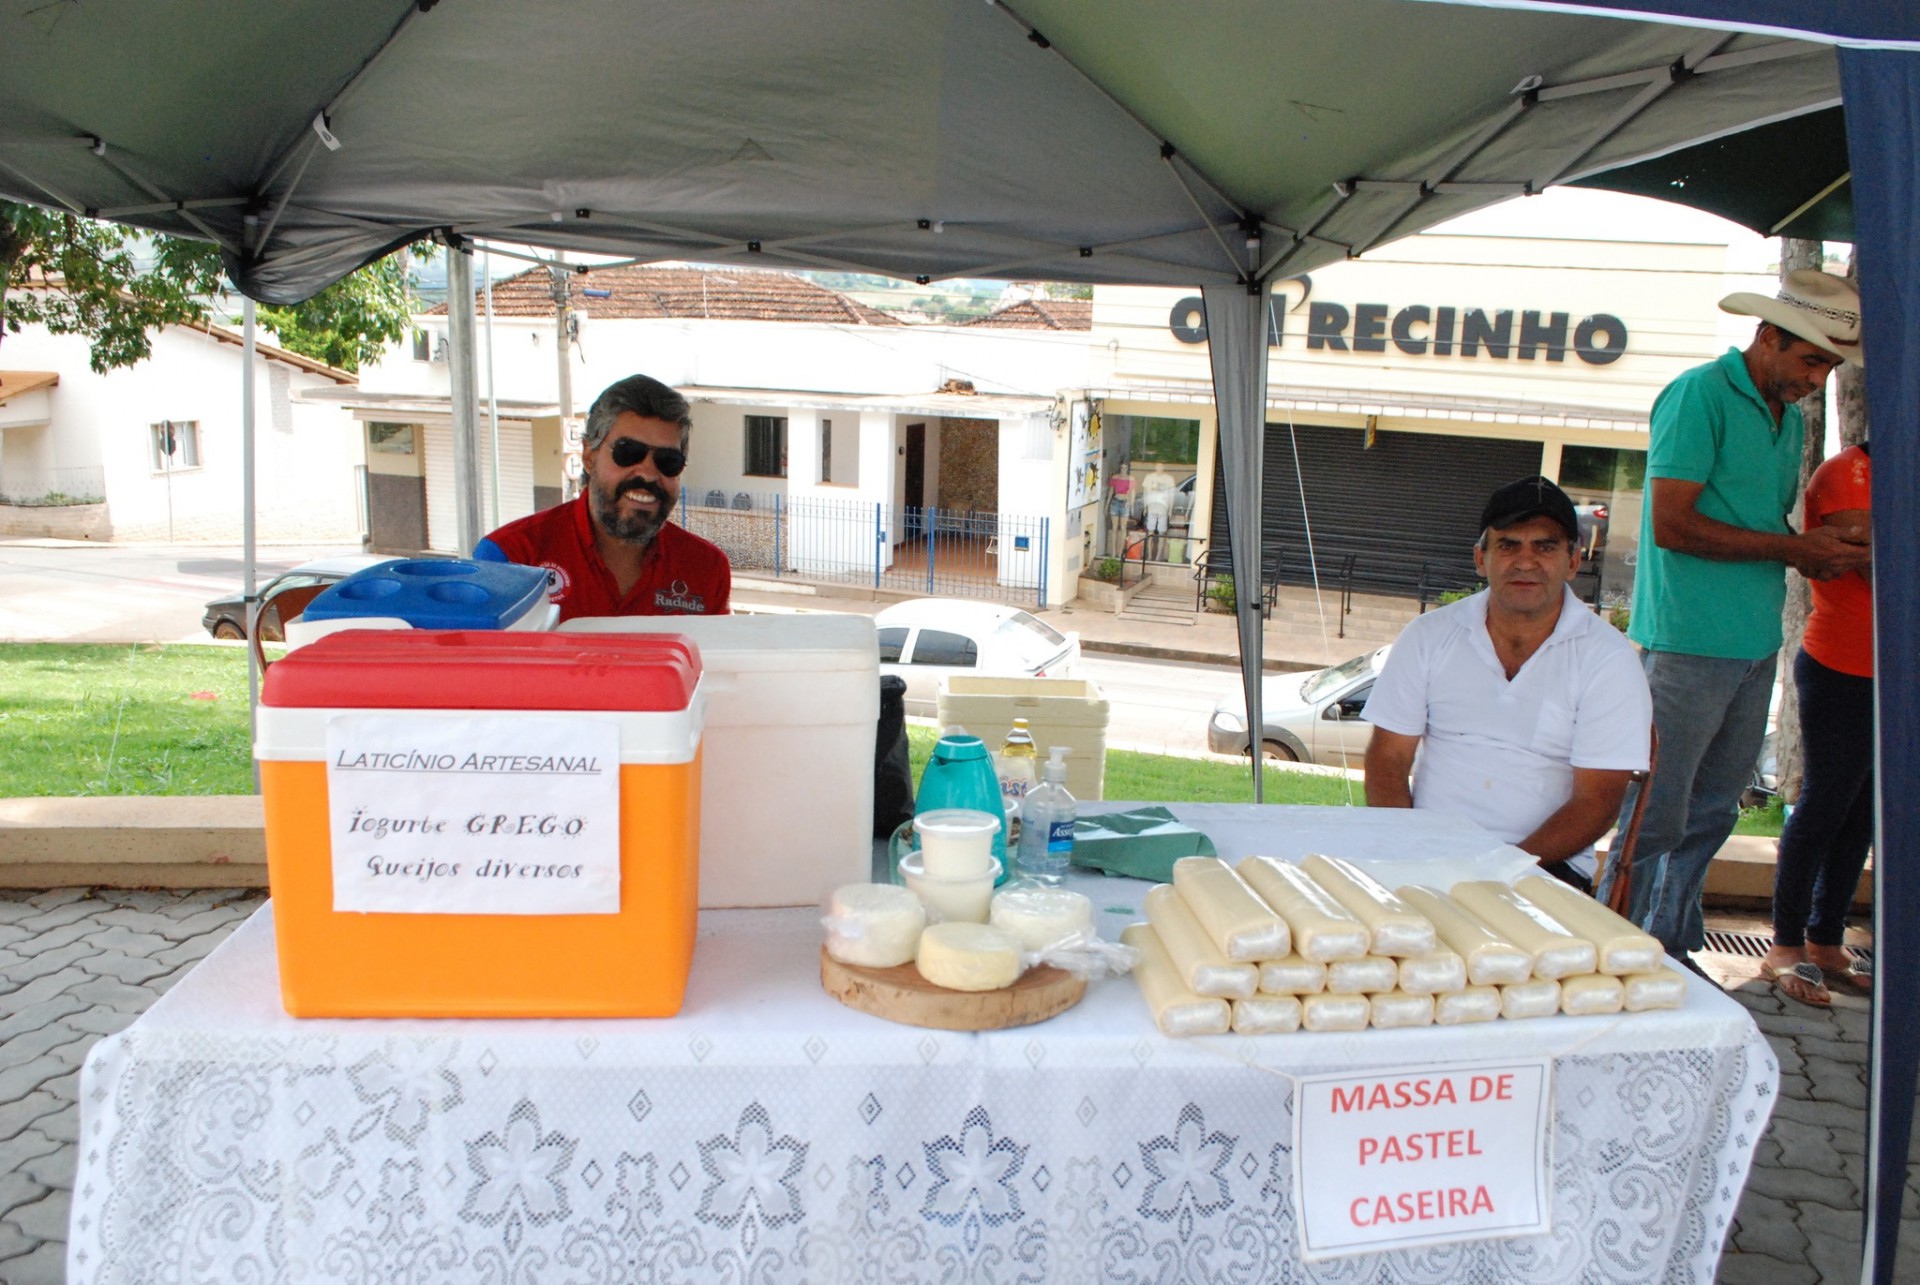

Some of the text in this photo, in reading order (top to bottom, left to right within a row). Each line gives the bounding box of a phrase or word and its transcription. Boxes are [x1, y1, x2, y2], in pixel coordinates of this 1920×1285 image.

[655, 593, 705, 612] Radade
[460, 753, 602, 772] ARTESANAL
[464, 812, 588, 838] GREGO
[366, 855, 584, 882] Queijos diversos
[1331, 1074, 1515, 1113] MASSA DE
[1358, 1129, 1483, 1166] PASTEL
[1350, 1185, 1495, 1228] CASEIRA
